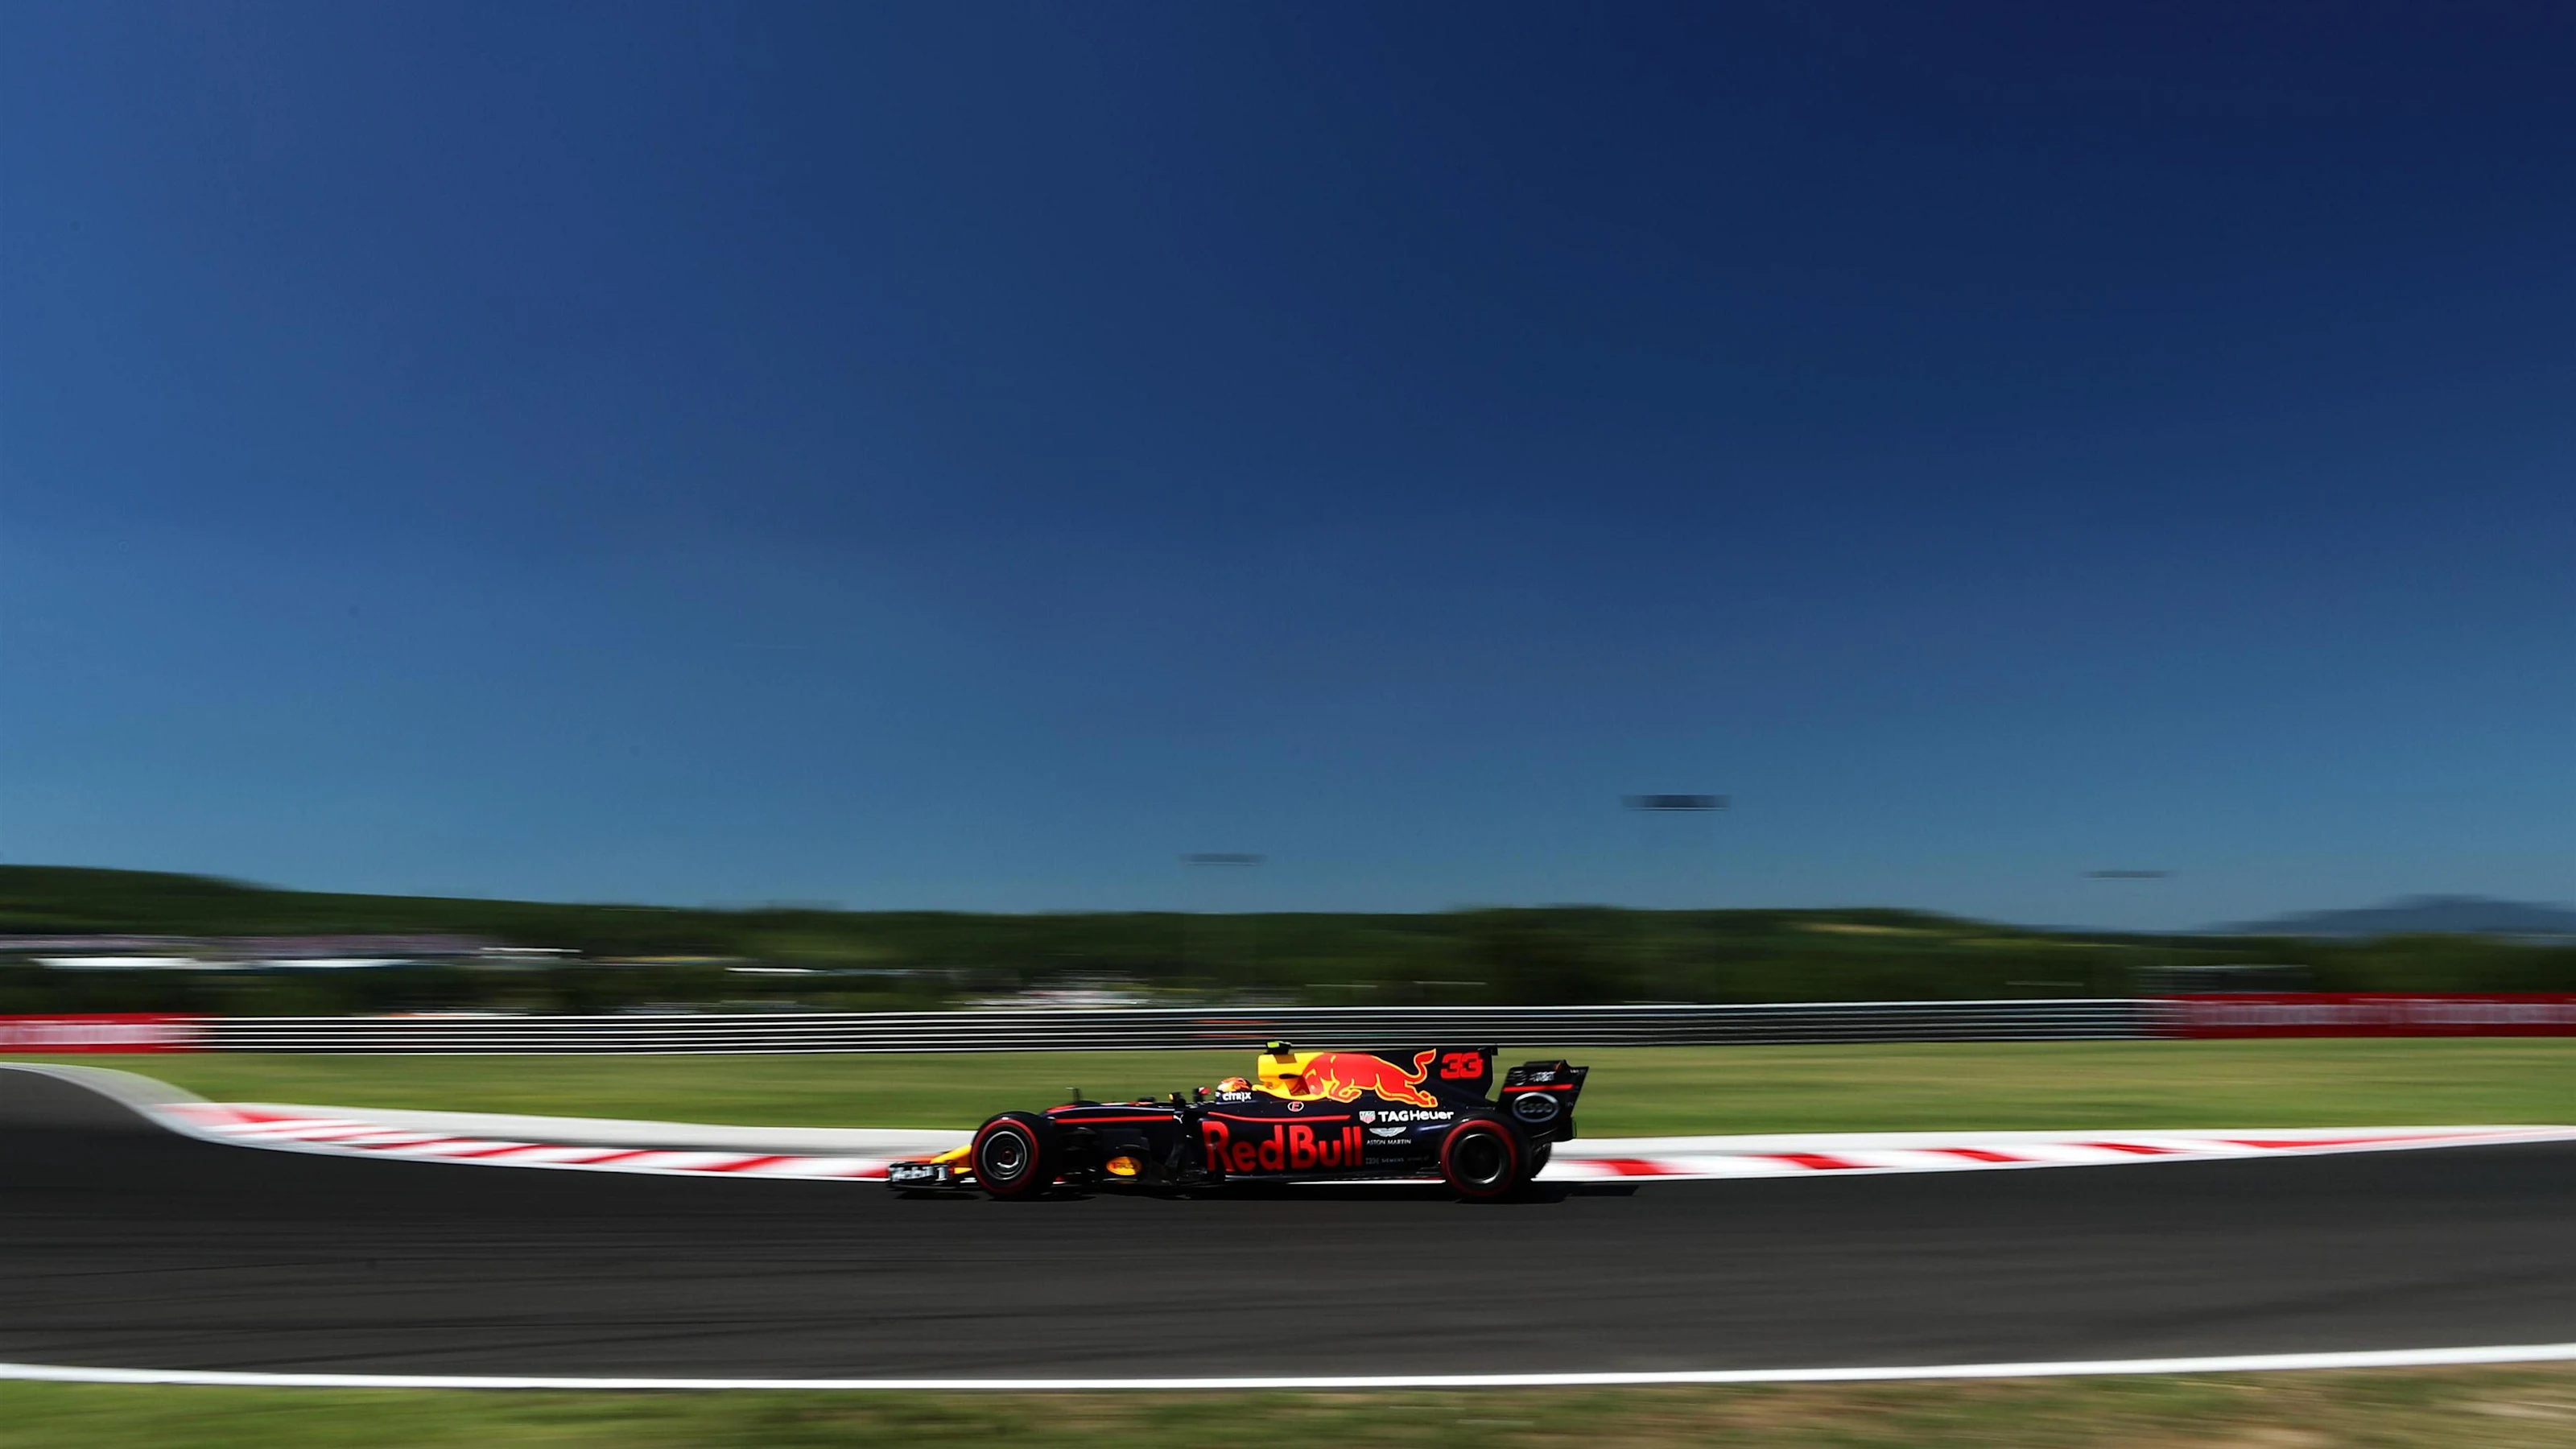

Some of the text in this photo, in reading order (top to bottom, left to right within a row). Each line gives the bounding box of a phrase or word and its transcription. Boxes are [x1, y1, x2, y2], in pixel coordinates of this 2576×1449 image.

[1440, 1052, 1483, 1079] 33
[1518, 1100, 1553, 1113] Esso
[935, 1166, 947, 1181] 1
